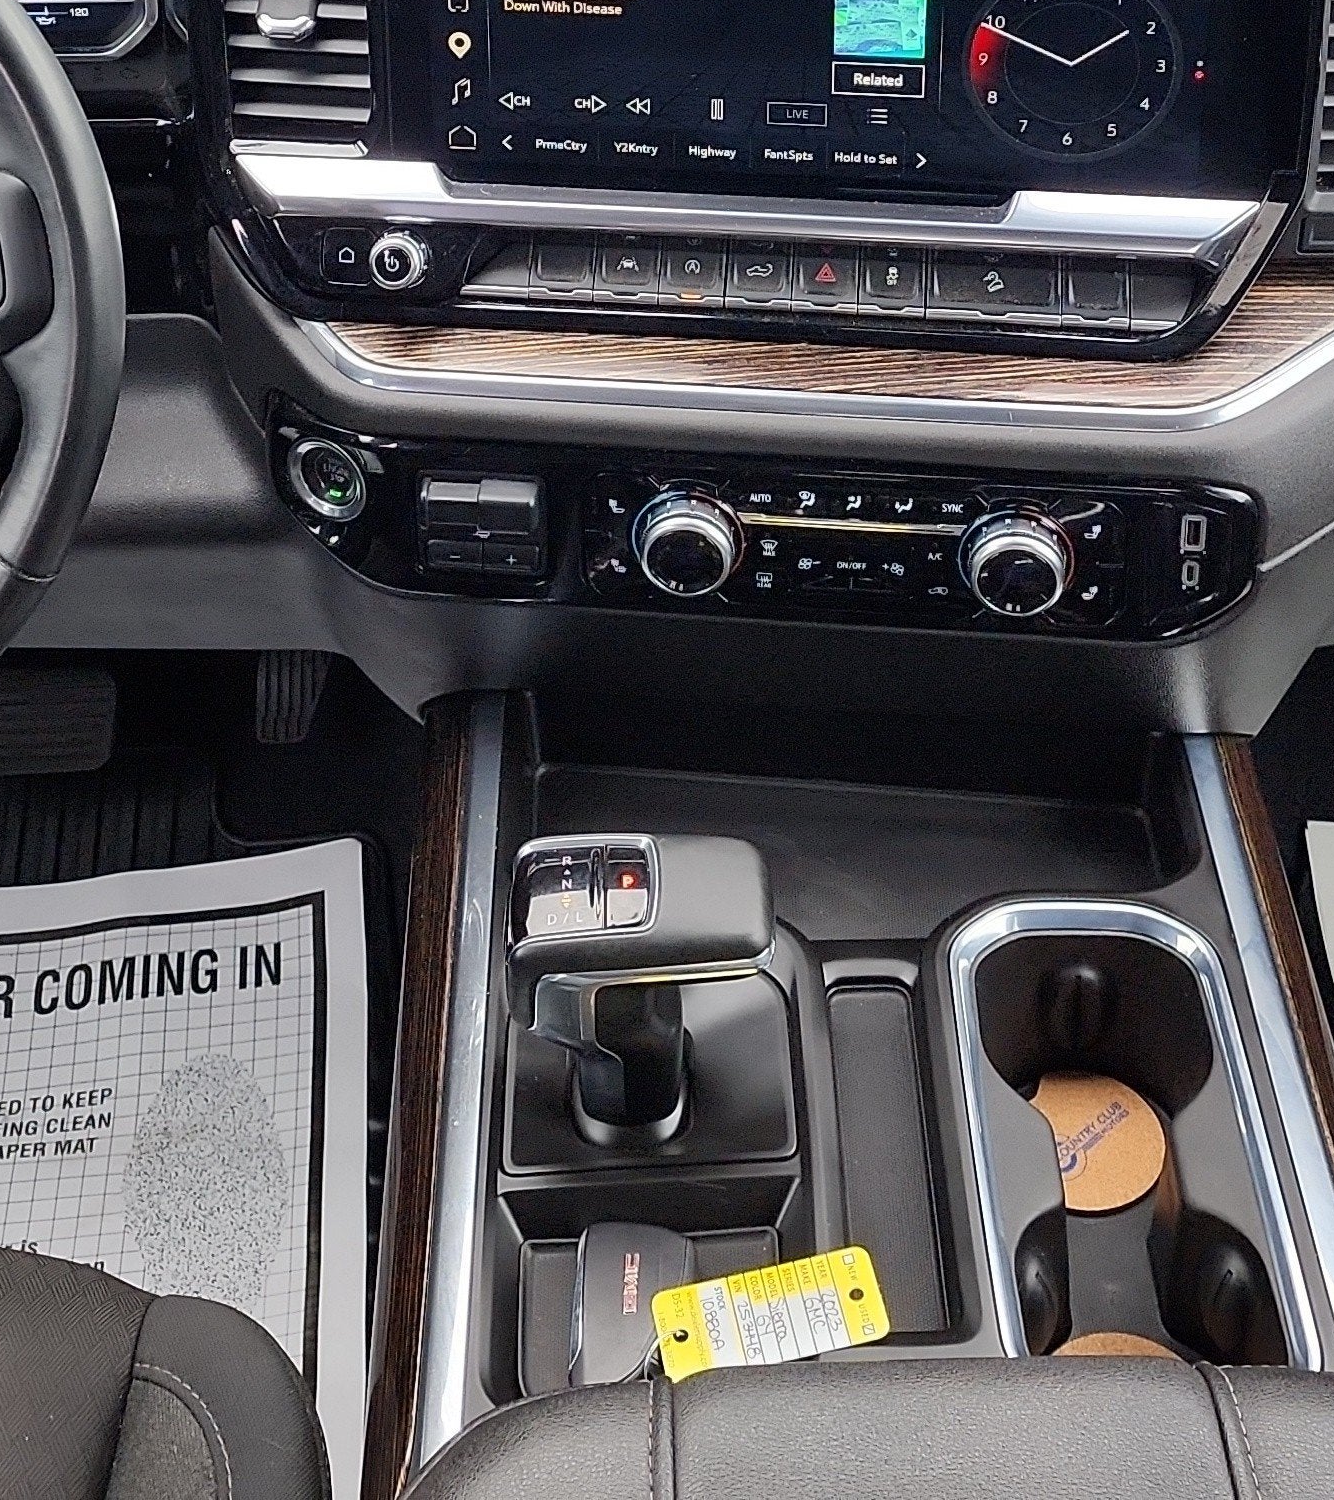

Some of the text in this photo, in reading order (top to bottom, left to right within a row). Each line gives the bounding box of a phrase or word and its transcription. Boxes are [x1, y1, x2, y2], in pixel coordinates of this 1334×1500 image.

[542, 0, 571, 13] With
[573, 1, 623, 15] Disease
[985, 14, 1006, 29] 10
[1145, 21, 1156, 35] 2
[978, 52, 989, 66] 9
[1155, 59, 1167, 73] 3
[853, 72, 904, 87] Related
[513, 95, 531, 107] CH
[574, 98, 591, 109] CH
[987, 90, 998, 105] 8
[1139, 96, 1151, 111] 4
[785, 108, 809, 120] LIVE
[1018, 119, 1029, 133] 7
[1106, 123, 1117, 137] 5
[1062, 131, 1073, 146] 6
[613, 141, 659, 157] Y2Kntry
[688, 145, 737, 160] Highway
[764, 148, 814, 163] FantSpts
[834, 151, 898, 165] Hold to Set
[749, 493, 772, 503] AUTO
[941, 503, 965, 514] SYNC
[927, 552, 944, 562] A/C
[562, 856, 572, 866] R
[561, 878, 573, 889] N
[622, 874, 635, 888] P
[547, 912, 583, 926] D L
[34, 948, 218, 1016] COMING
[238, 942, 282, 990] IN
[29, 1095, 55, 1113] TO
[62, 1087, 113, 1109] KEEP
[45, 1112, 112, 1135] CLEAN
[1059, 1101, 1122, 1159] OUNTRY CLUB
[53, 1137, 99, 1156] MAT
[799, 1263, 812, 1285] MAKE
[816, 1259, 828, 1279] YEAR
[846, 1265, 858, 1281] NEW
[623, 1252, 641, 1315] GMC
[733, 1279, 743, 1293] VIN
[749, 1275, 763, 1301] COLOR
[766, 1272, 778, 1298] MODEL
[782, 1268, 796, 1293] SERIES
[713, 1286, 726, 1311] STOCK
[821, 1289, 843, 1332] 2023
[858, 1303, 870, 1324] USED
